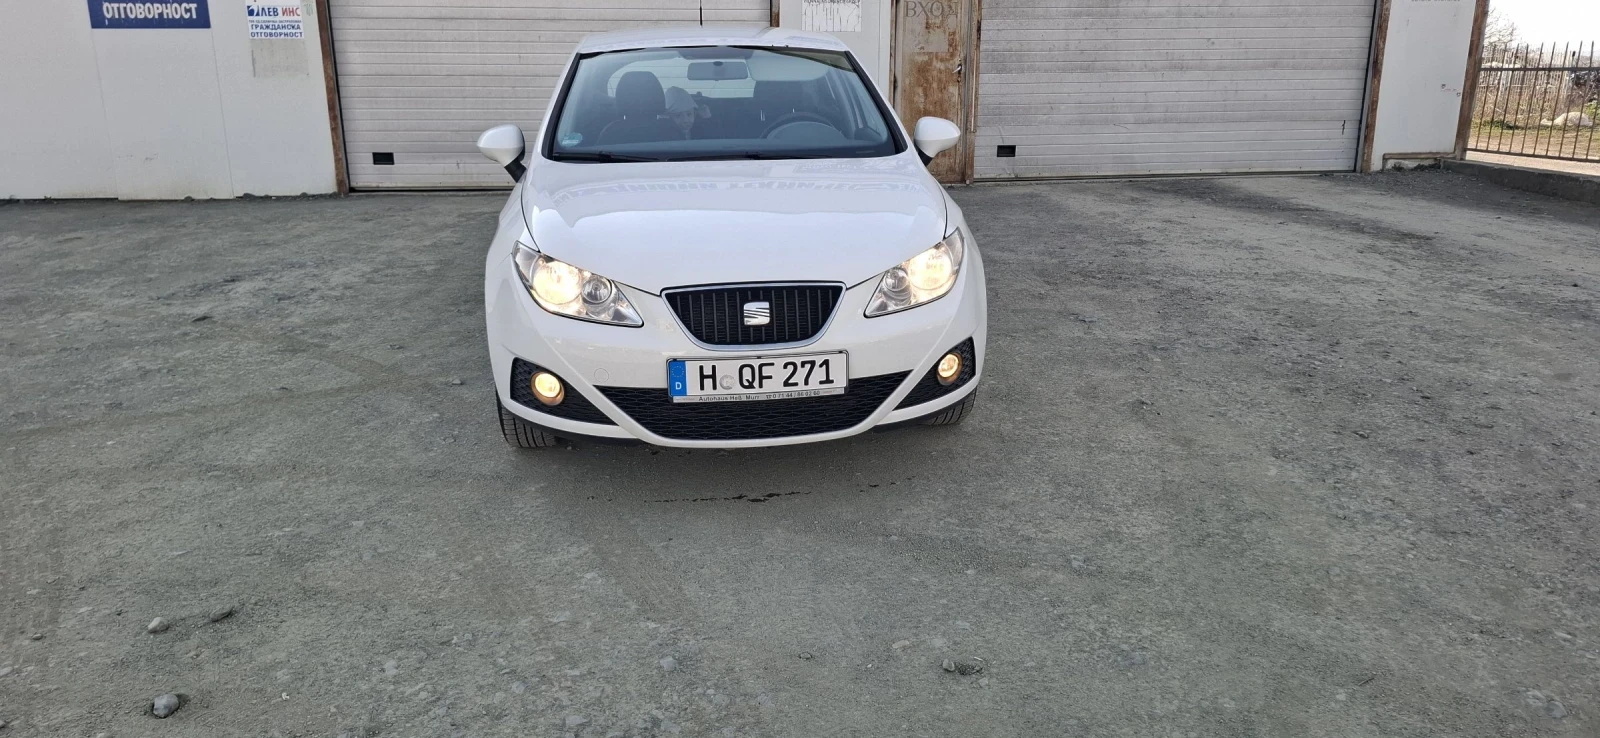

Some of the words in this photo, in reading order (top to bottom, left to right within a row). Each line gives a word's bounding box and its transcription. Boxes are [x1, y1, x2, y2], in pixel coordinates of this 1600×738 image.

[102, 2, 197, 19] ОТГОВОРНОСТ
[261, 7, 279, 17] ЛЕВ
[281, 7, 300, 16] ИНС
[905, 1, 958, 18] ВХОД
[699, 364, 717, 391] H
[738, 362, 775, 390] QF
[782, 358, 835, 387] 271
[674, 381, 682, 390] D
